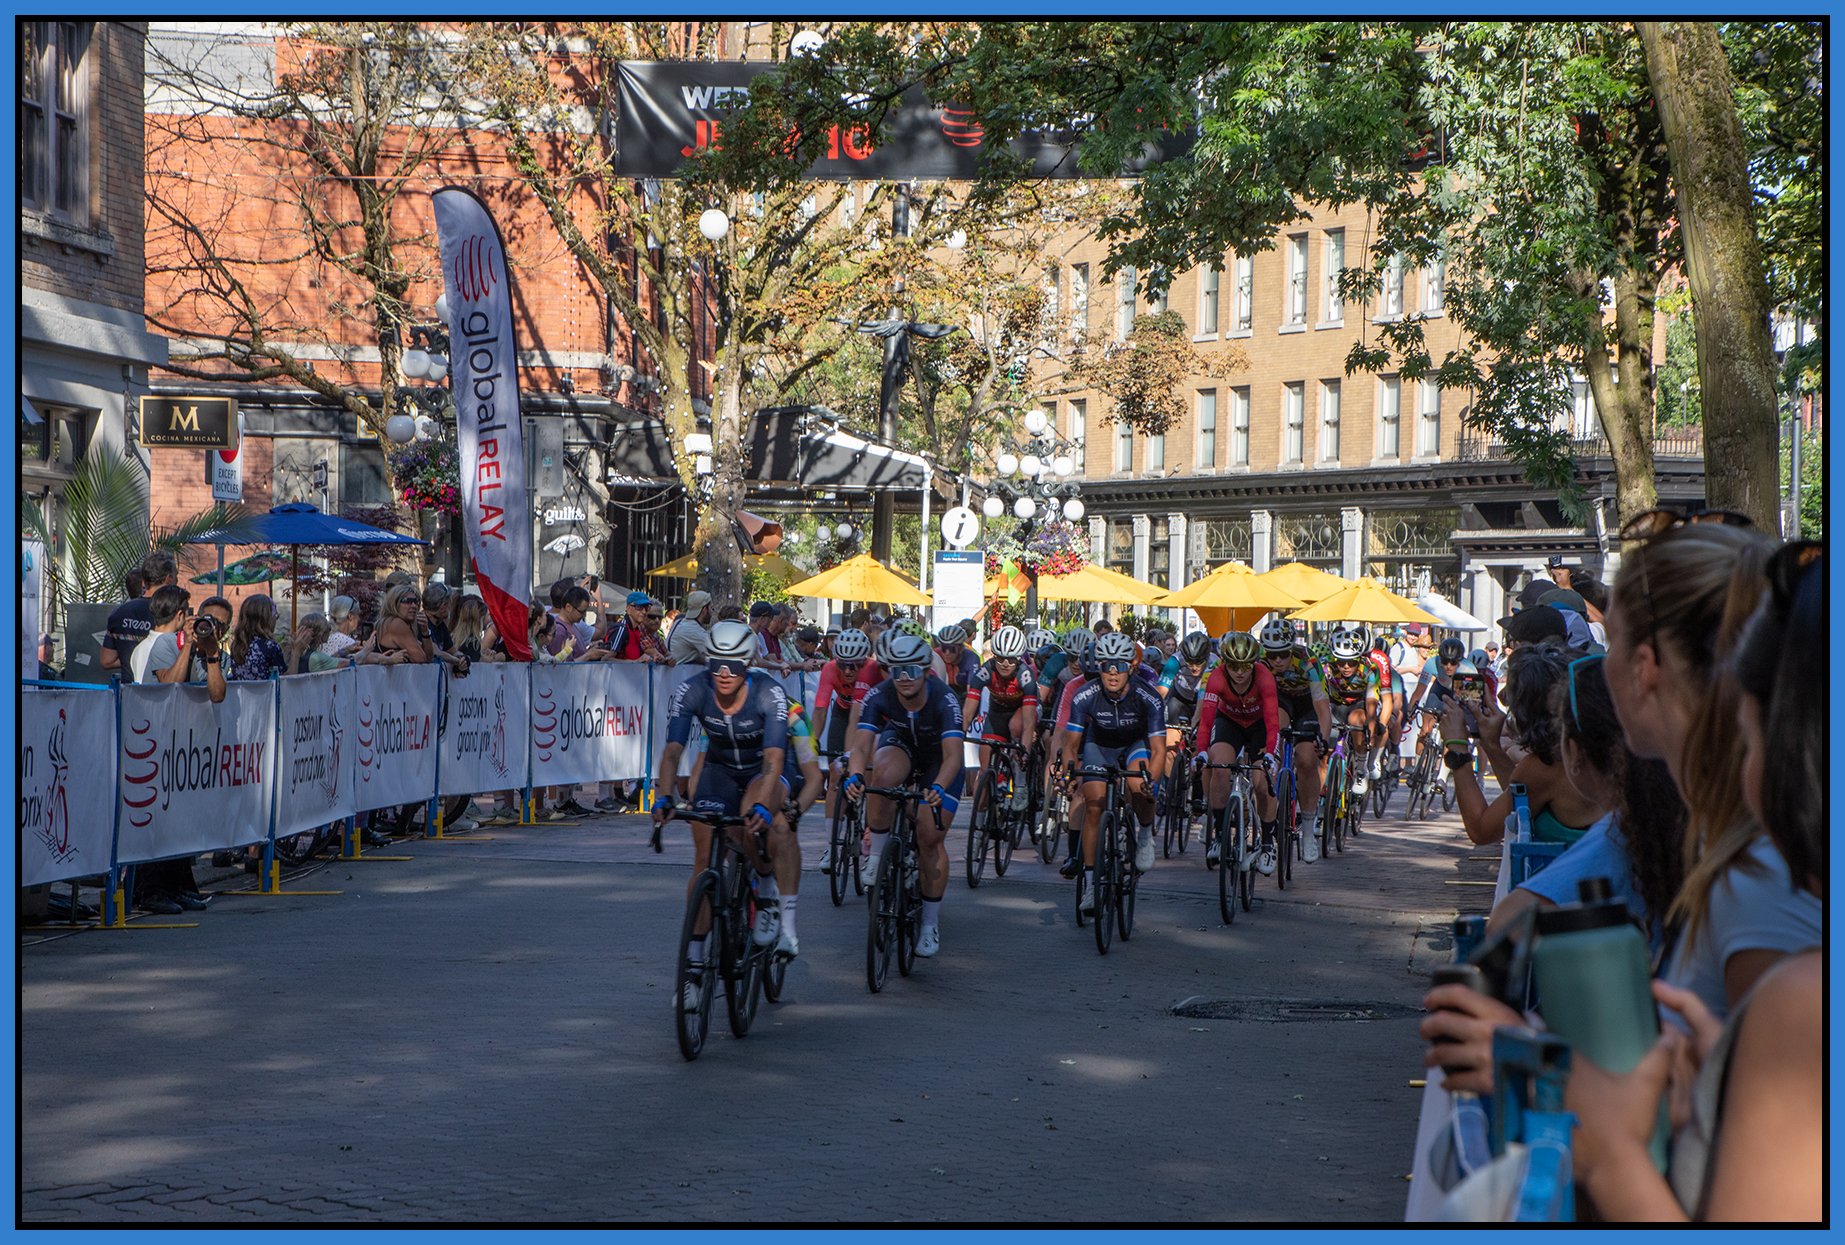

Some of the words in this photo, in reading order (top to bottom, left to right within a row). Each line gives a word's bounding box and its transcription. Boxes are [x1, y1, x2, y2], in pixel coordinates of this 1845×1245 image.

[169, 405, 200, 431] M
[150, 434, 179, 442] COCINA
[218, 468, 237, 479] EXCEPT
[215, 481, 239, 495] BICYCLES
